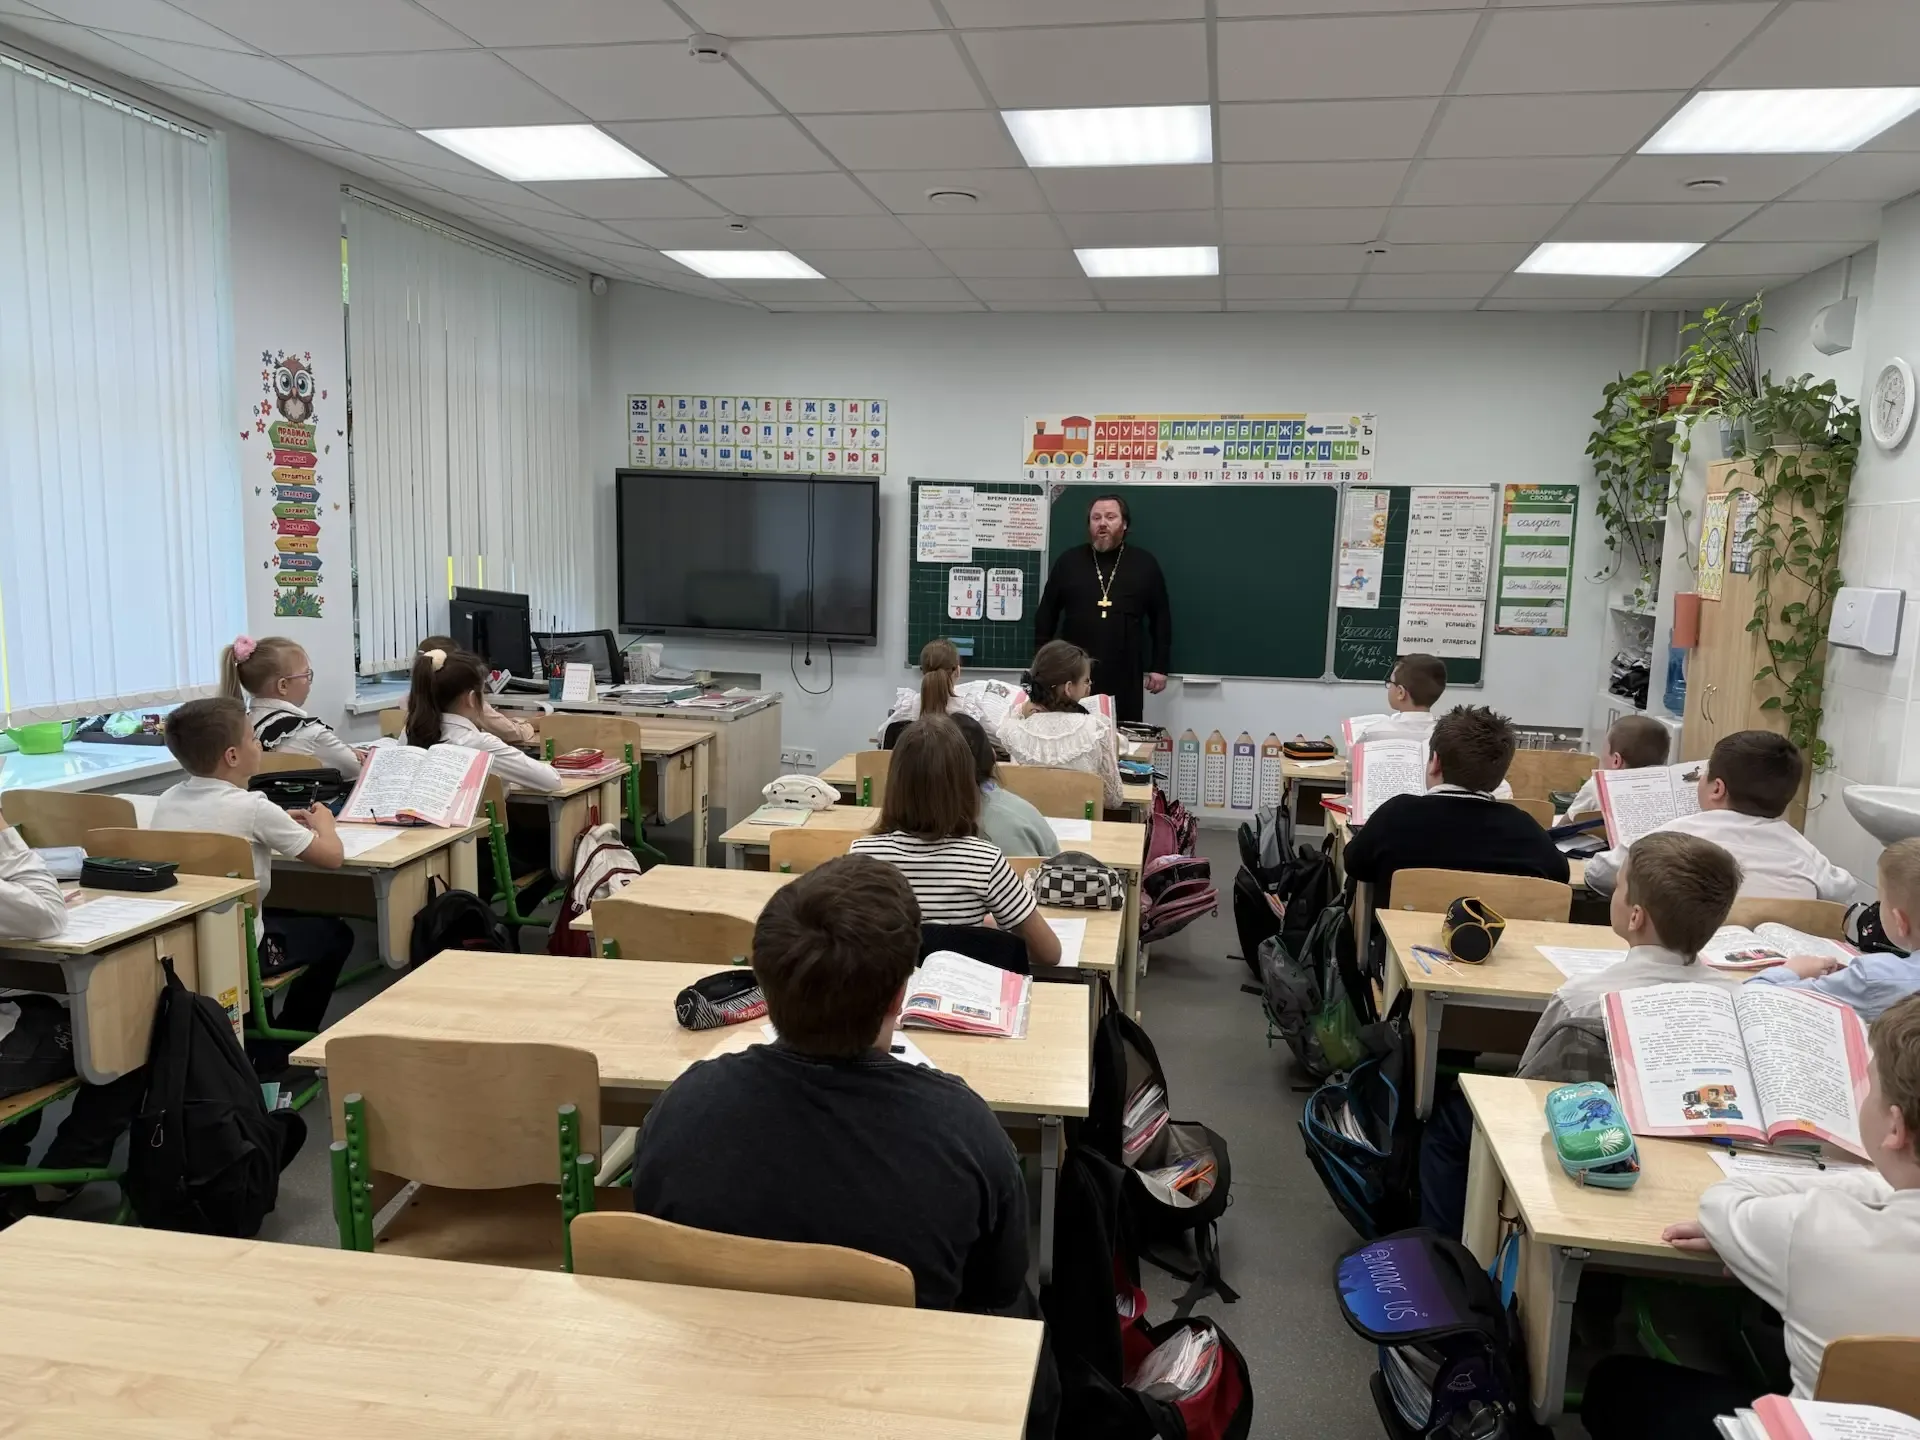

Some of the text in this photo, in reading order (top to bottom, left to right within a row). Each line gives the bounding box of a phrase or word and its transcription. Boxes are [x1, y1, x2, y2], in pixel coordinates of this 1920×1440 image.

[632, 400, 647, 410] 33
[658, 400, 880, 413] А Б В Г Д Е Ё Ж З И Й
[278, 427, 311, 438] ПРАВИЛА
[658, 424, 880, 438] К Л М Н О П Р С Т У Ф
[1096, 424, 1302, 437] А О У Ы Э Й Л М Н Р Б В Г Д Ж З
[1362, 426, 1372, 435] Ъ
[280, 436, 308, 446] КЛАССА
[1096, 444, 1154, 455] Я Ё Ю И Е
[1226, 446, 1370, 456] П Ф К Т Ш С Х Ц Ч Щ Ь
[659, 448, 878, 463] Х Ц Ч Ш Щ Ъ Ы Ь Э Ю Я
[1029, 471, 1034, 479] 0
[1045, 471, 1049, 479] 1
[1060, 471, 1065, 479] 2
[1076, 471, 1081, 479] 3
[1092, 471, 1097, 479] 4
[1108, 471, 1114, 479] 5
[1125, 471, 1129, 479] 6
[1141, 471, 1146, 479] 7
[1157, 471, 1162, 479] 8
[1173, 471, 1178, 479] 9
[1188, 471, 1197, 479] 10
[1205, 471, 1213, 479] 11
[1221, 471, 1230, 479] 12
[1238, 471, 1247, 479] 13
[1254, 471, 1264, 479] 14
